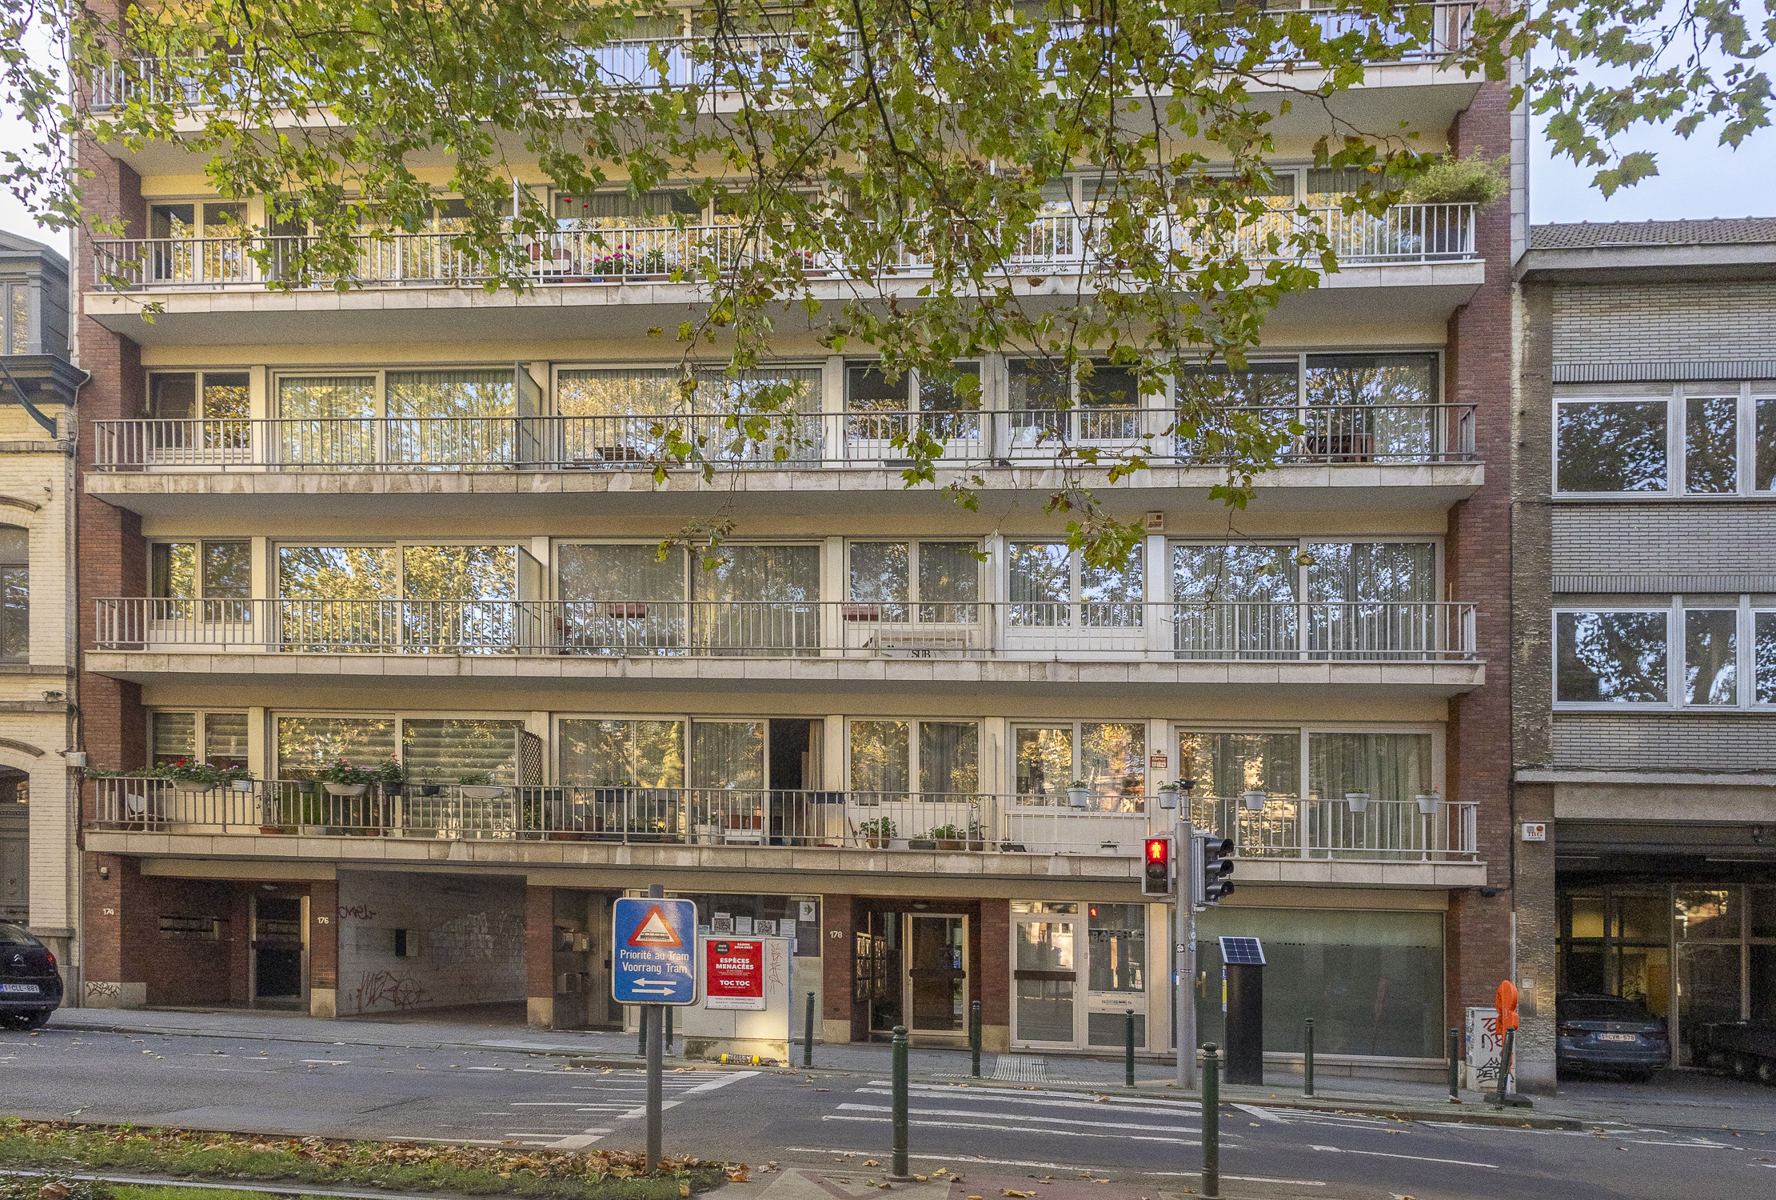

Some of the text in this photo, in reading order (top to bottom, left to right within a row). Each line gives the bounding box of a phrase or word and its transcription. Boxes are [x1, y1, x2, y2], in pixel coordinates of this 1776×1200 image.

[102, 908, 115, 916] 174
[317, 917, 330, 925] 176
[829, 931, 843, 939] 178
[620, 949, 690, 961] Priorité au Tram
[622, 961, 688, 975] Voorrang Tram
